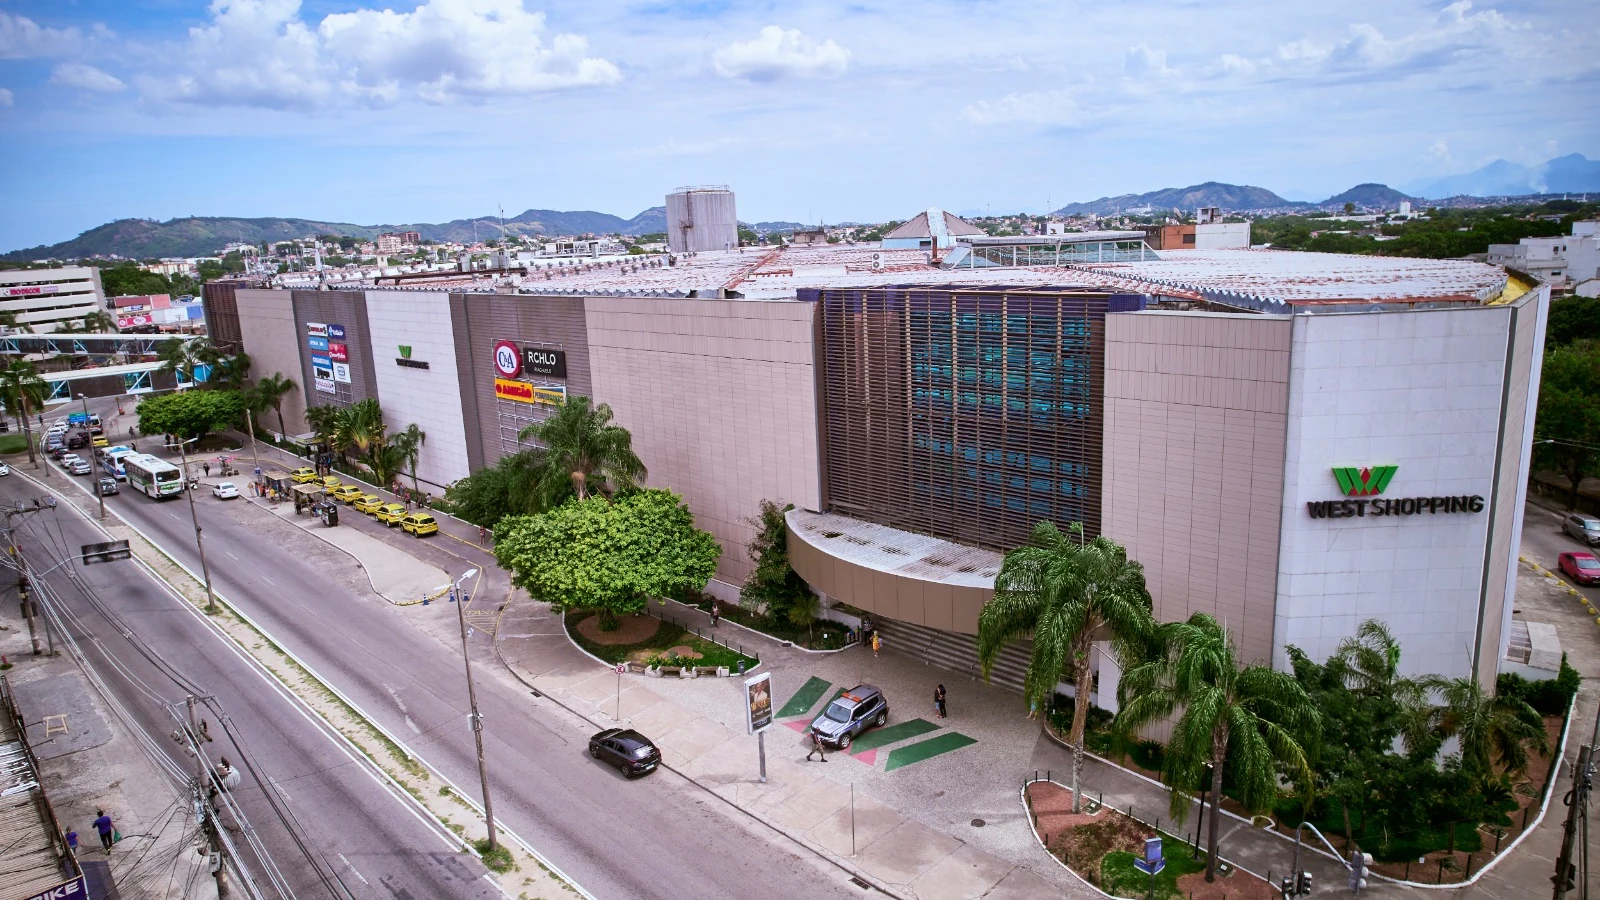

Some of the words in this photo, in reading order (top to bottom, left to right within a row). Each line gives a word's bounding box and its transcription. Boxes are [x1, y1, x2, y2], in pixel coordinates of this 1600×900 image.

[498, 351, 515, 369] C&A
[527, 351, 556, 366] RCHLO
[1307, 500, 1370, 519] WEST
[1370, 494, 1485, 517] SHOPPING
